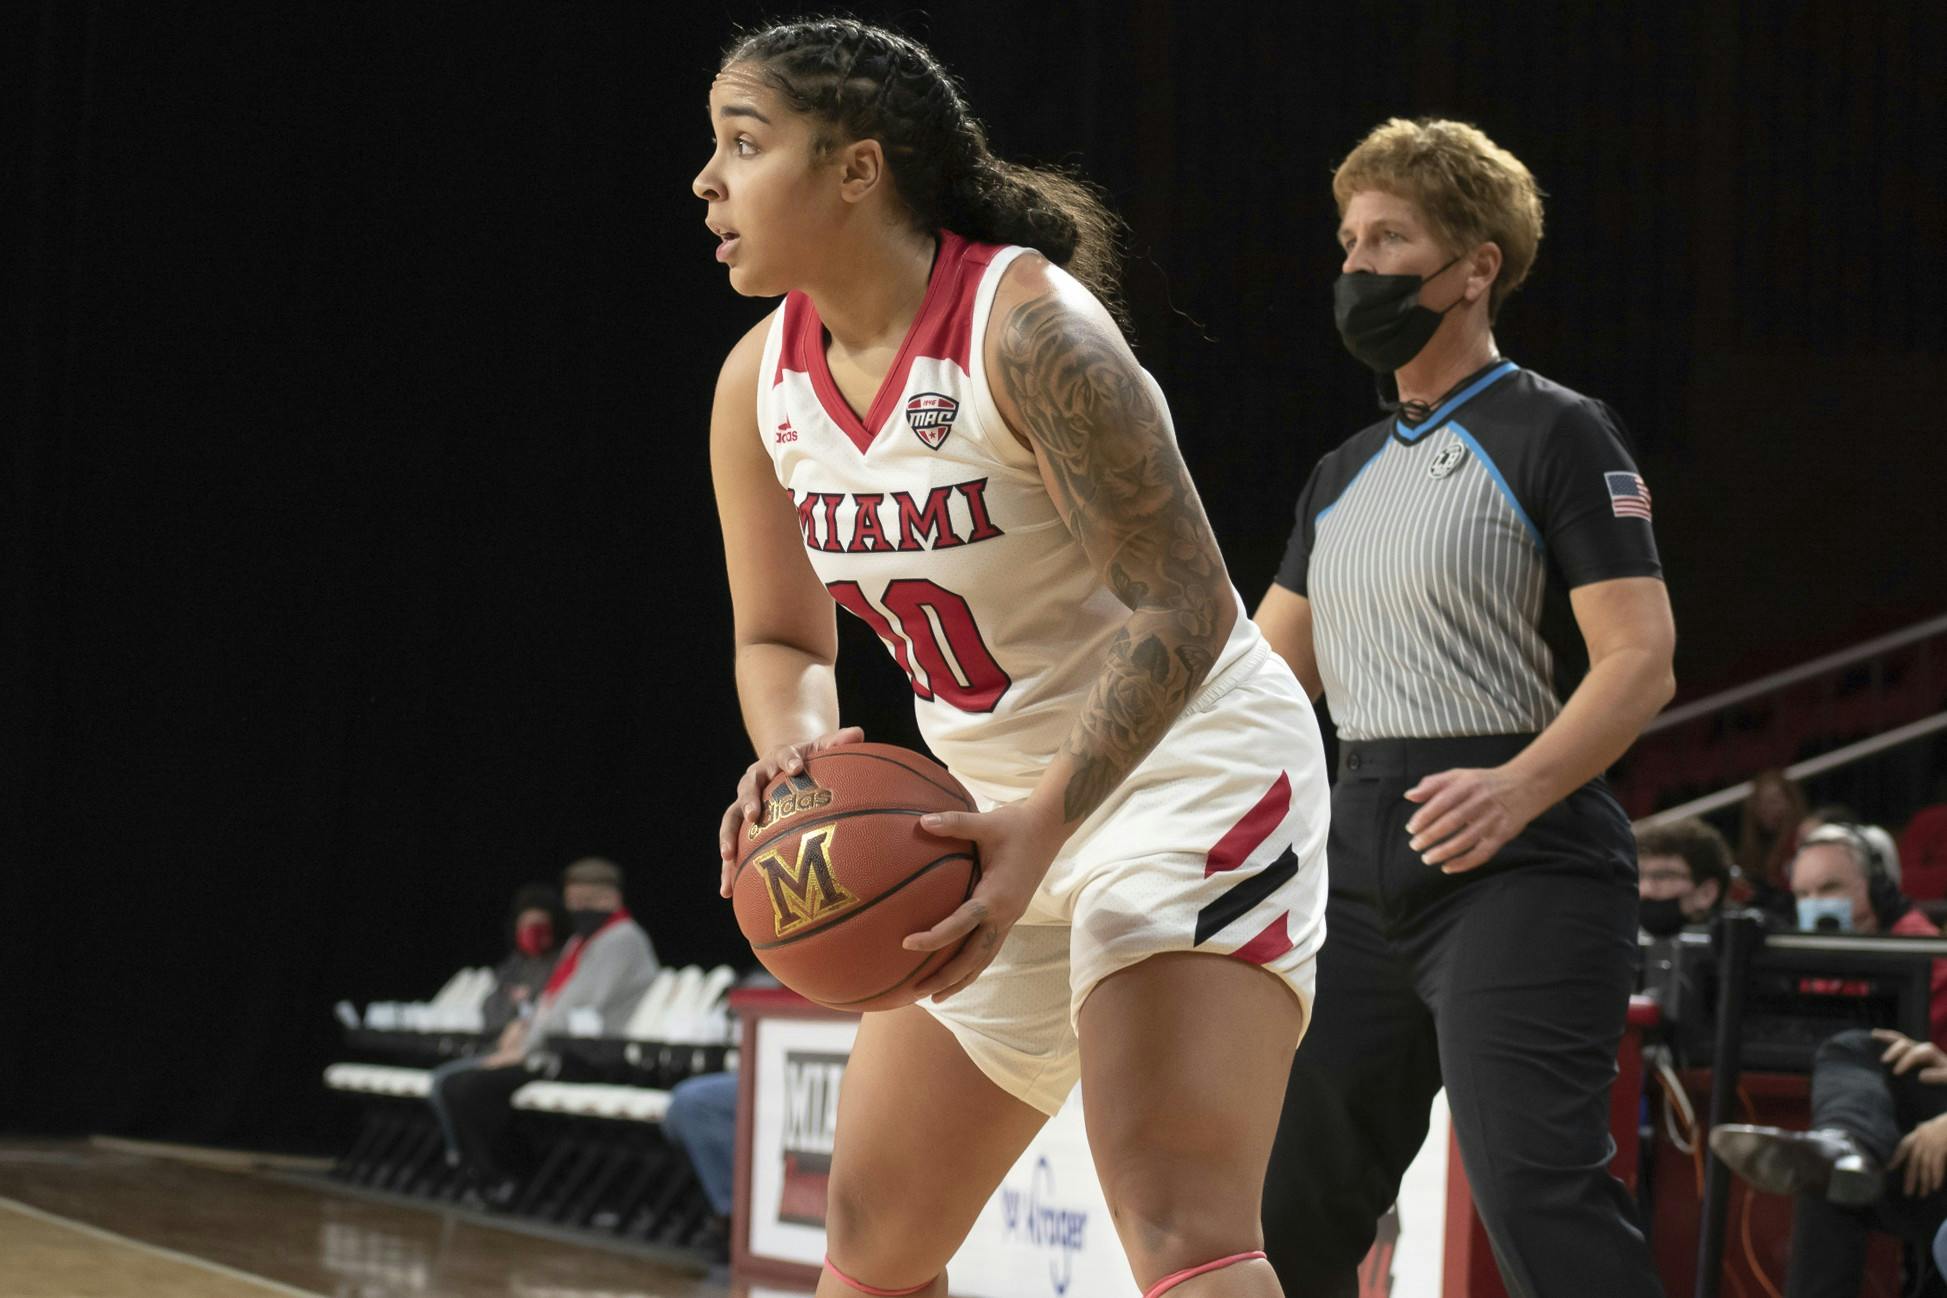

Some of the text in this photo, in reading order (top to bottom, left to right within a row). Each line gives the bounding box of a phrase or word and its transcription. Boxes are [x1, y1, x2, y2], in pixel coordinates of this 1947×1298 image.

[910, 411, 954, 427] MAC
[787, 476, 1005, 553] MIAMI
[753, 822, 860, 937] M
